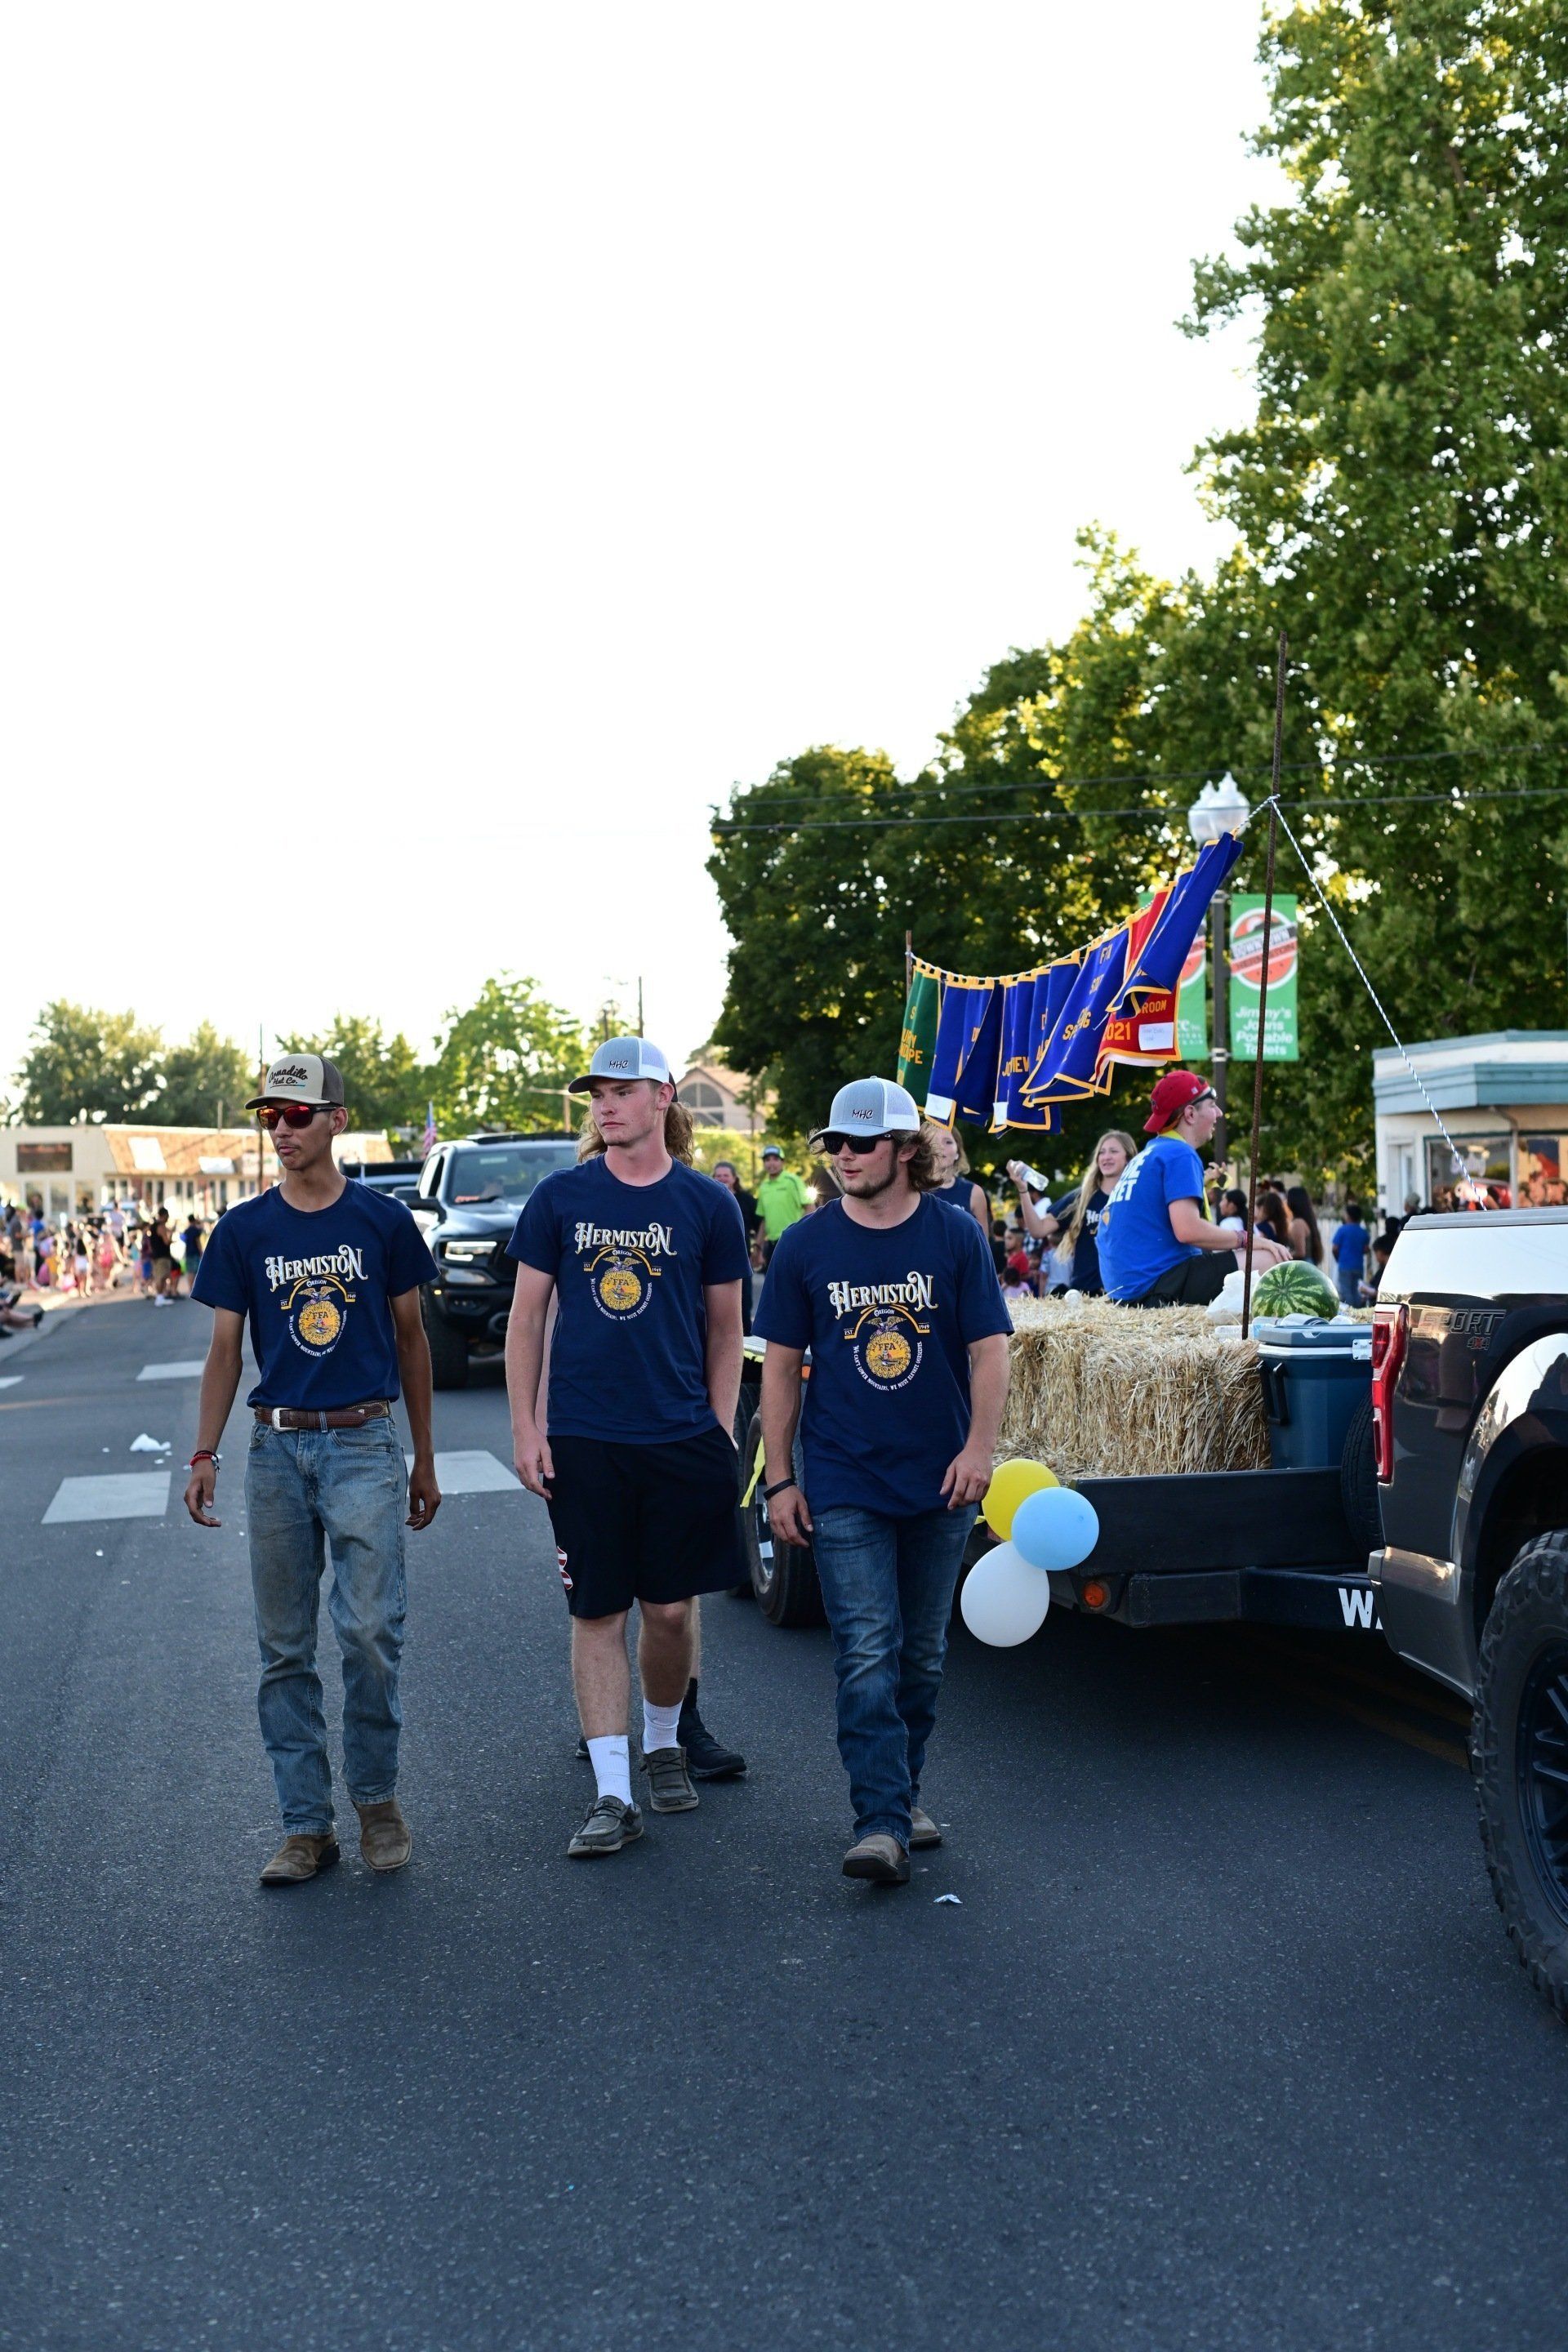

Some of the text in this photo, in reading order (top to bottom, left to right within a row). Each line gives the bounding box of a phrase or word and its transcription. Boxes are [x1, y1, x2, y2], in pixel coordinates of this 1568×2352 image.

[1105, 1022, 1131, 1040] 021
[609, 1060, 628, 1069] MHC
[269, 1065, 308, 1083] Armadillo
[853, 1109, 873, 1119] MHC
[575, 1222, 678, 1257] HERMISTON
[265, 1244, 368, 1292] HERMISTON
[827, 1271, 938, 1320] HERMISTON
[313, 1312, 329, 1320] FFA
